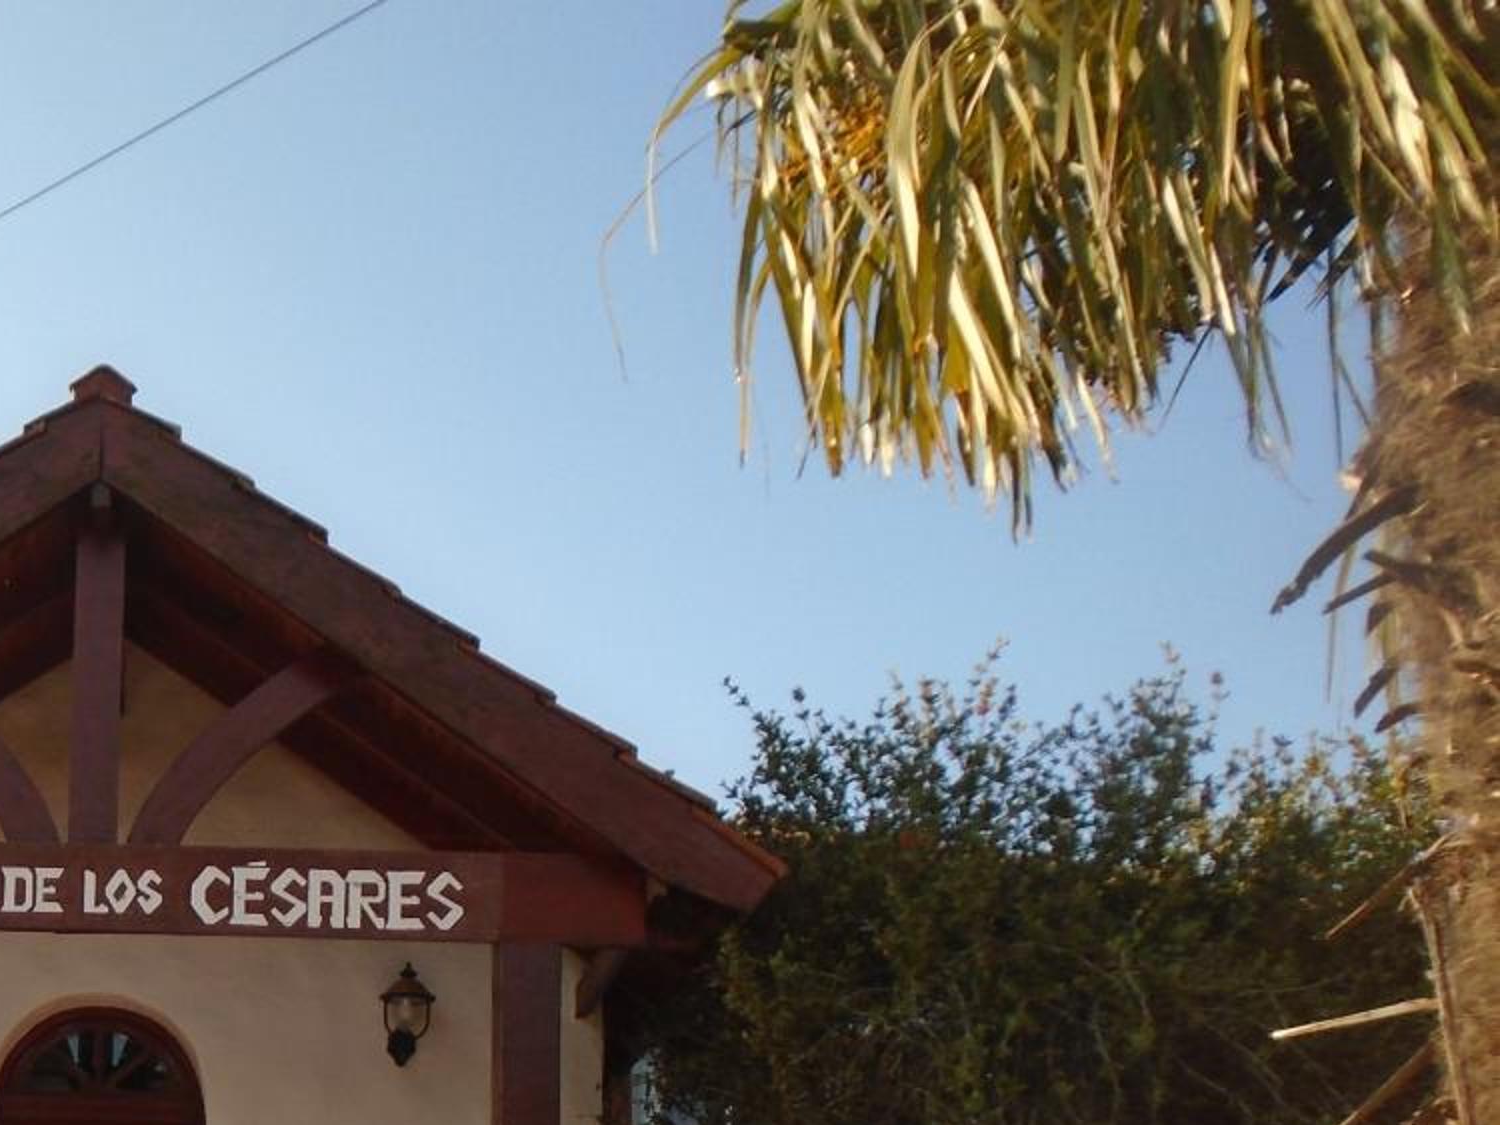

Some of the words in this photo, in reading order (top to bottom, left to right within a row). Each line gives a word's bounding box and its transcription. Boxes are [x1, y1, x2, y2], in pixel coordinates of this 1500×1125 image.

[1, 867, 65, 913] DE
[83, 868, 164, 914] LOS
[191, 861, 464, 931] CÉSARES
